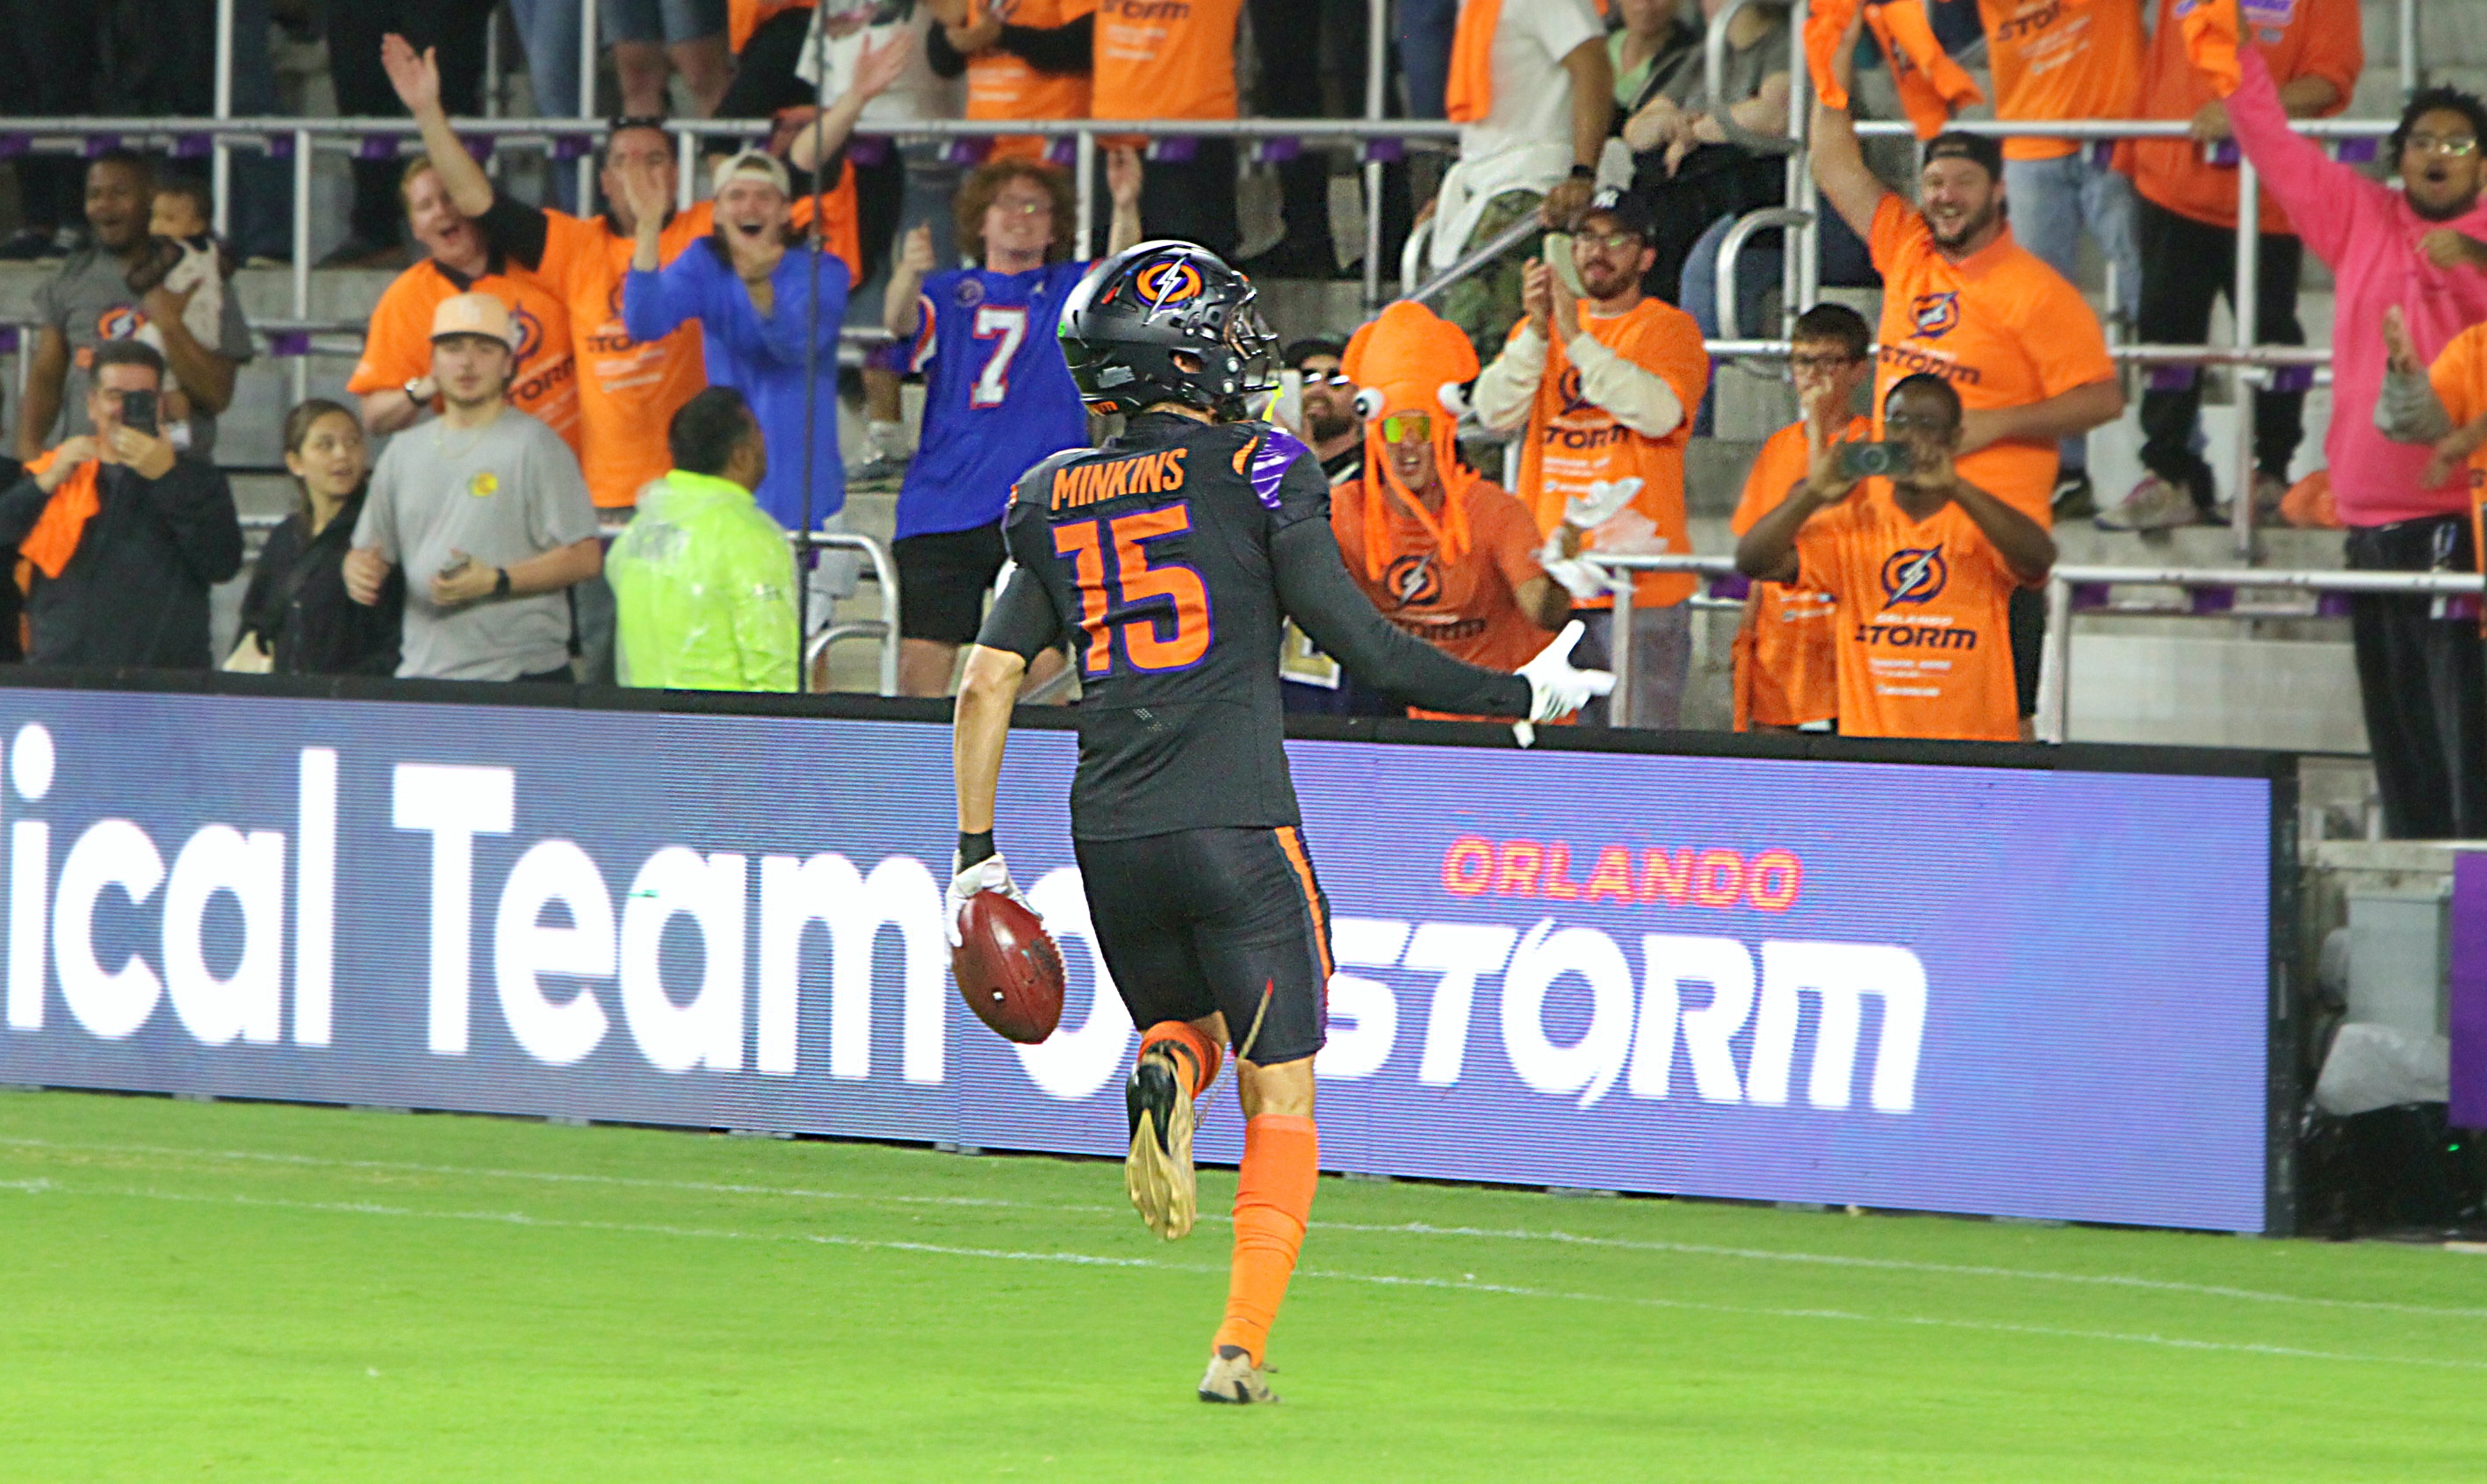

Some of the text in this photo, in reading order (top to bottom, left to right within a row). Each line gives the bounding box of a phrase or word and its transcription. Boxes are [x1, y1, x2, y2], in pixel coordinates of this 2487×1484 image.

[970, 304, 1029, 410] 7
[1051, 448, 1188, 511] MINKINS
[1052, 501, 1213, 674] 15
[0, 724, 338, 1045] ical
[393, 762, 955, 1084] Team
[1441, 835, 1803, 913] ORLANDO
